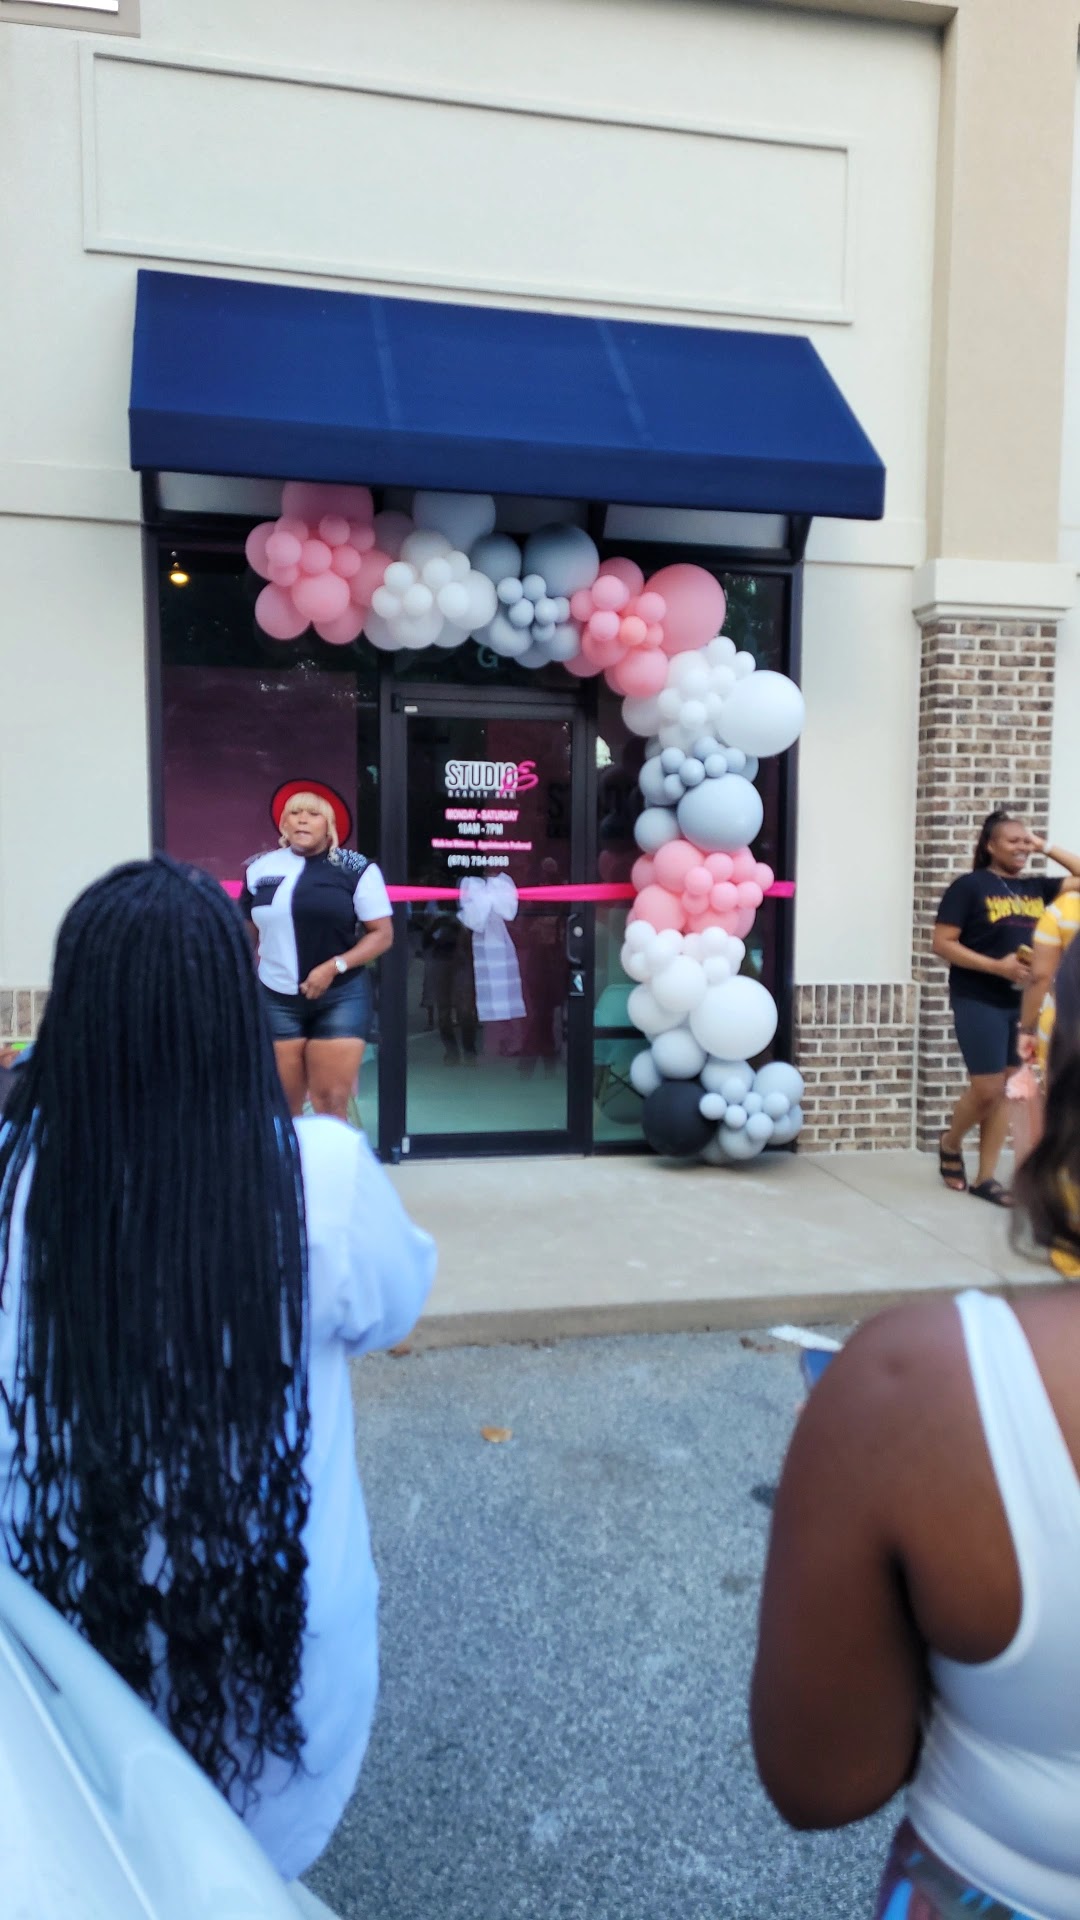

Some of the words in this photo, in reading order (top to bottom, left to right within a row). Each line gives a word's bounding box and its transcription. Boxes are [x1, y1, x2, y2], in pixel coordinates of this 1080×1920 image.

[445, 760, 518, 790] STUDIO
[458, 822, 480, 835] 10AM
[485, 823, 504, 836] 7PM
